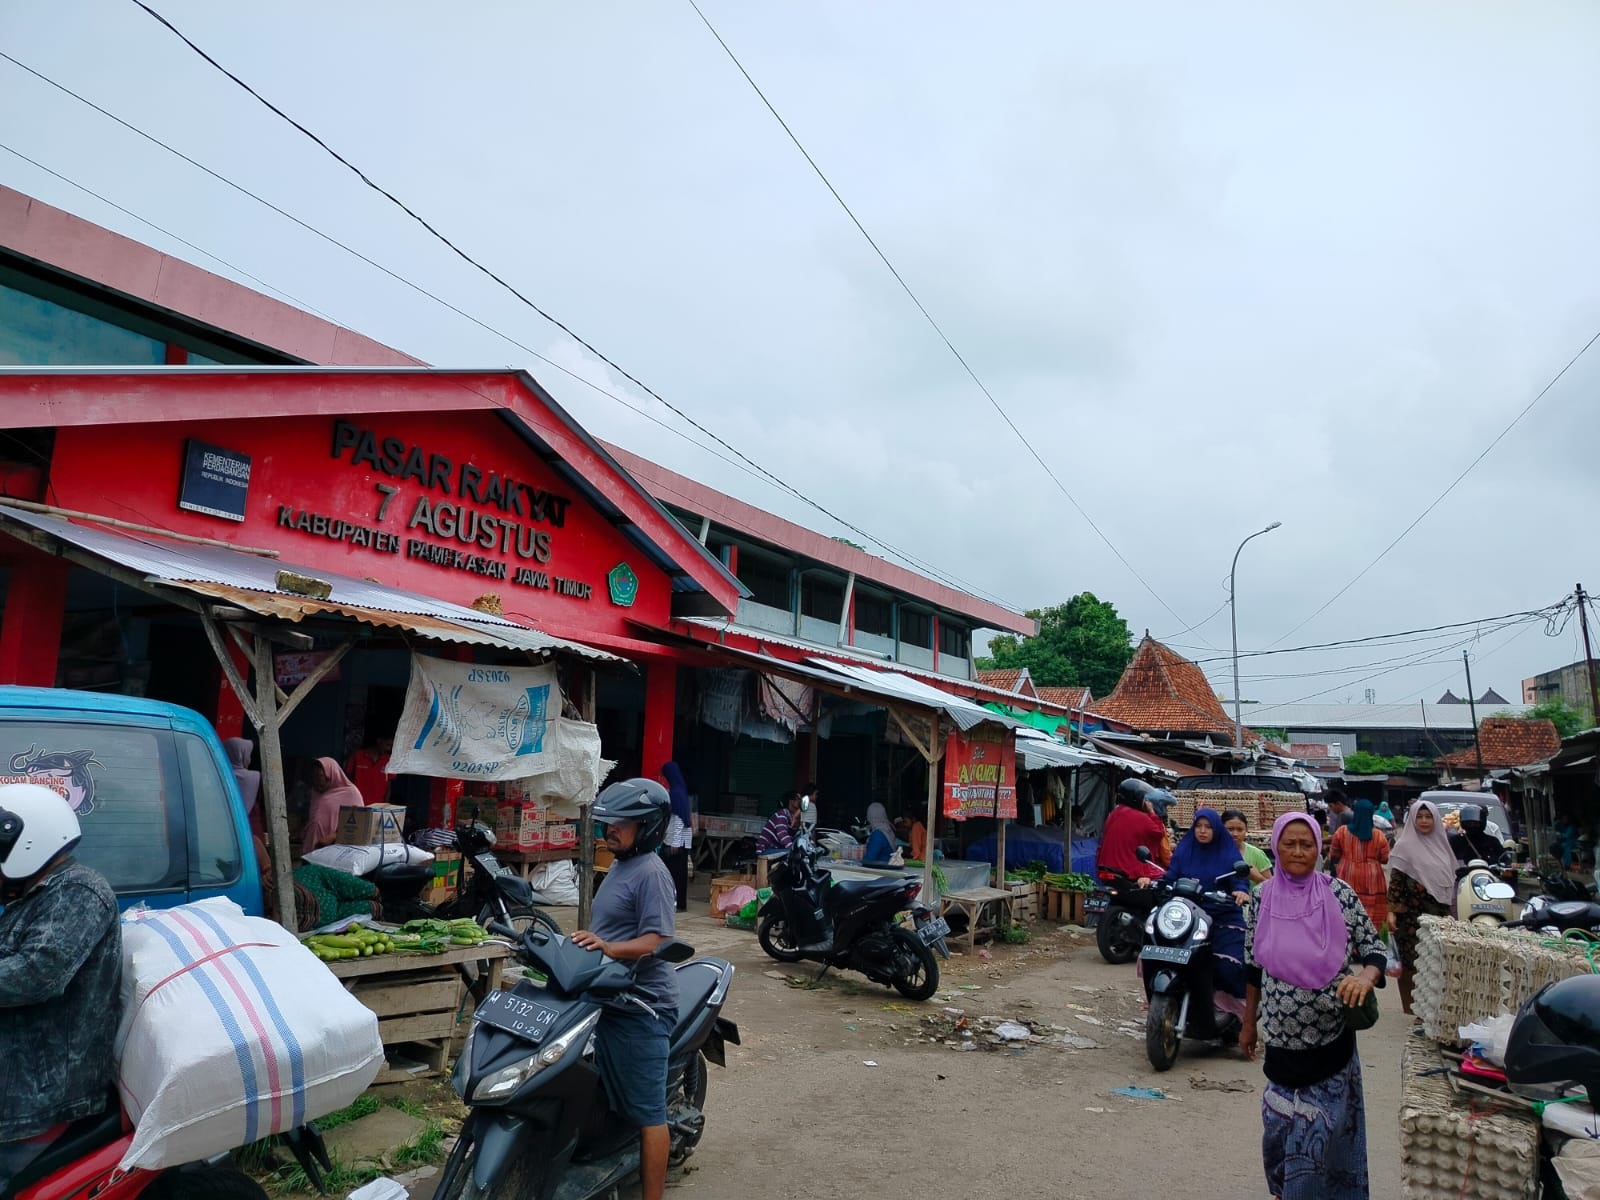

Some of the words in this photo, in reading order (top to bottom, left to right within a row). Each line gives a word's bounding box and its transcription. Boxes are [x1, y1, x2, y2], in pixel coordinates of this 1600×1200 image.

[203, 460, 250, 479] PERDAGANGAN
[204, 452, 251, 472] KEMENTERIAN
[332, 420, 452, 493] PASAR
[459, 464, 571, 528] RAKYAT
[376, 483, 398, 522] 7
[409, 495, 552, 563] AGUSTUS
[278, 505, 401, 554] KABUPATEN
[512, 566, 550, 590] JAWA
[554, 576, 592, 600] TIMUR
[452, 760, 499, 774] 9203SP
[0, 777, 27, 785] KOLAM
[488, 992, 501, 1005] M
[504, 997, 533, 1017] 5132
[536, 1010, 554, 1025] CN
